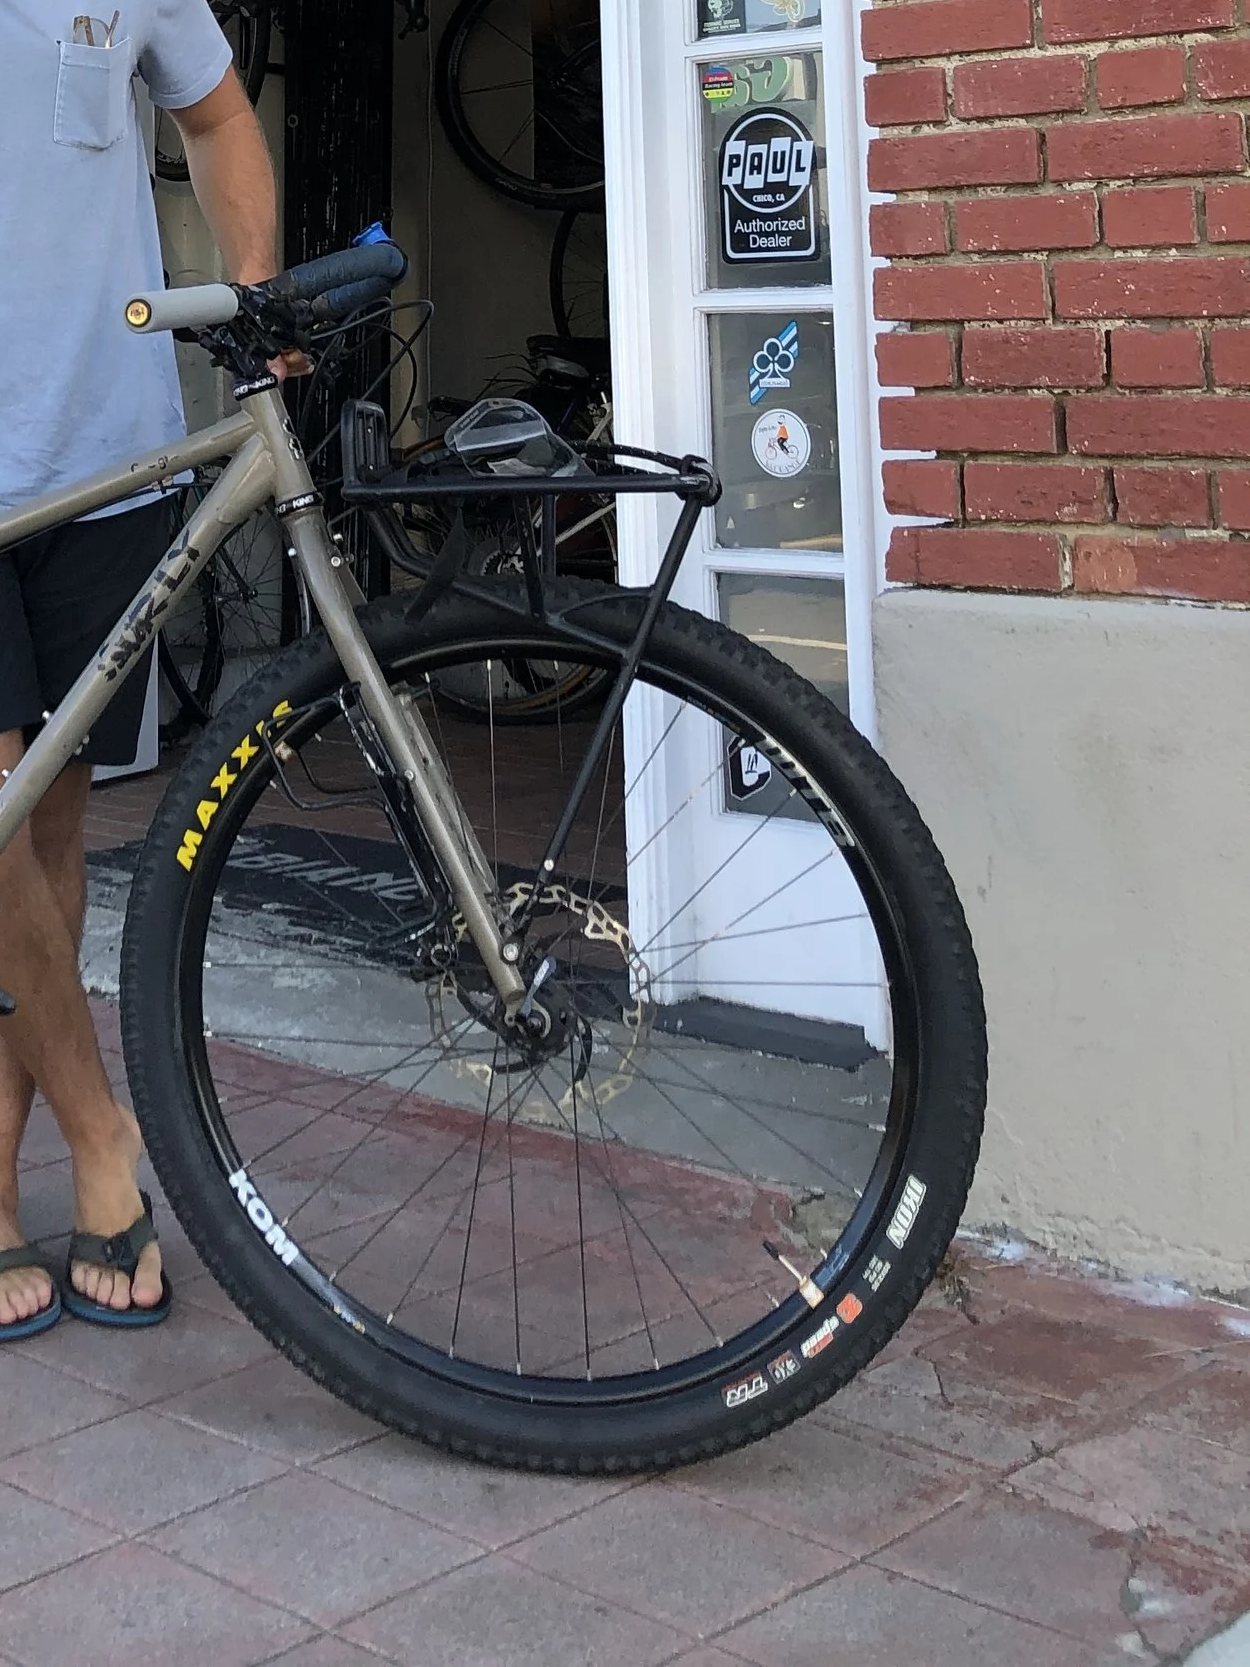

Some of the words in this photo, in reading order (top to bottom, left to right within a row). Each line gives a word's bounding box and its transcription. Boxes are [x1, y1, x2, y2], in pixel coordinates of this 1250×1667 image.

[727, 149, 806, 177] PAUL
[753, 194, 775, 203] CHICO,
[776, 193, 785, 201] CA
[734, 216, 806, 233] Authorized
[750, 234, 792, 248] Dealer
[293, 496, 314, 507] KING
[229, 1168, 299, 1265] KOM
[887, 1174, 926, 1249] IKON
